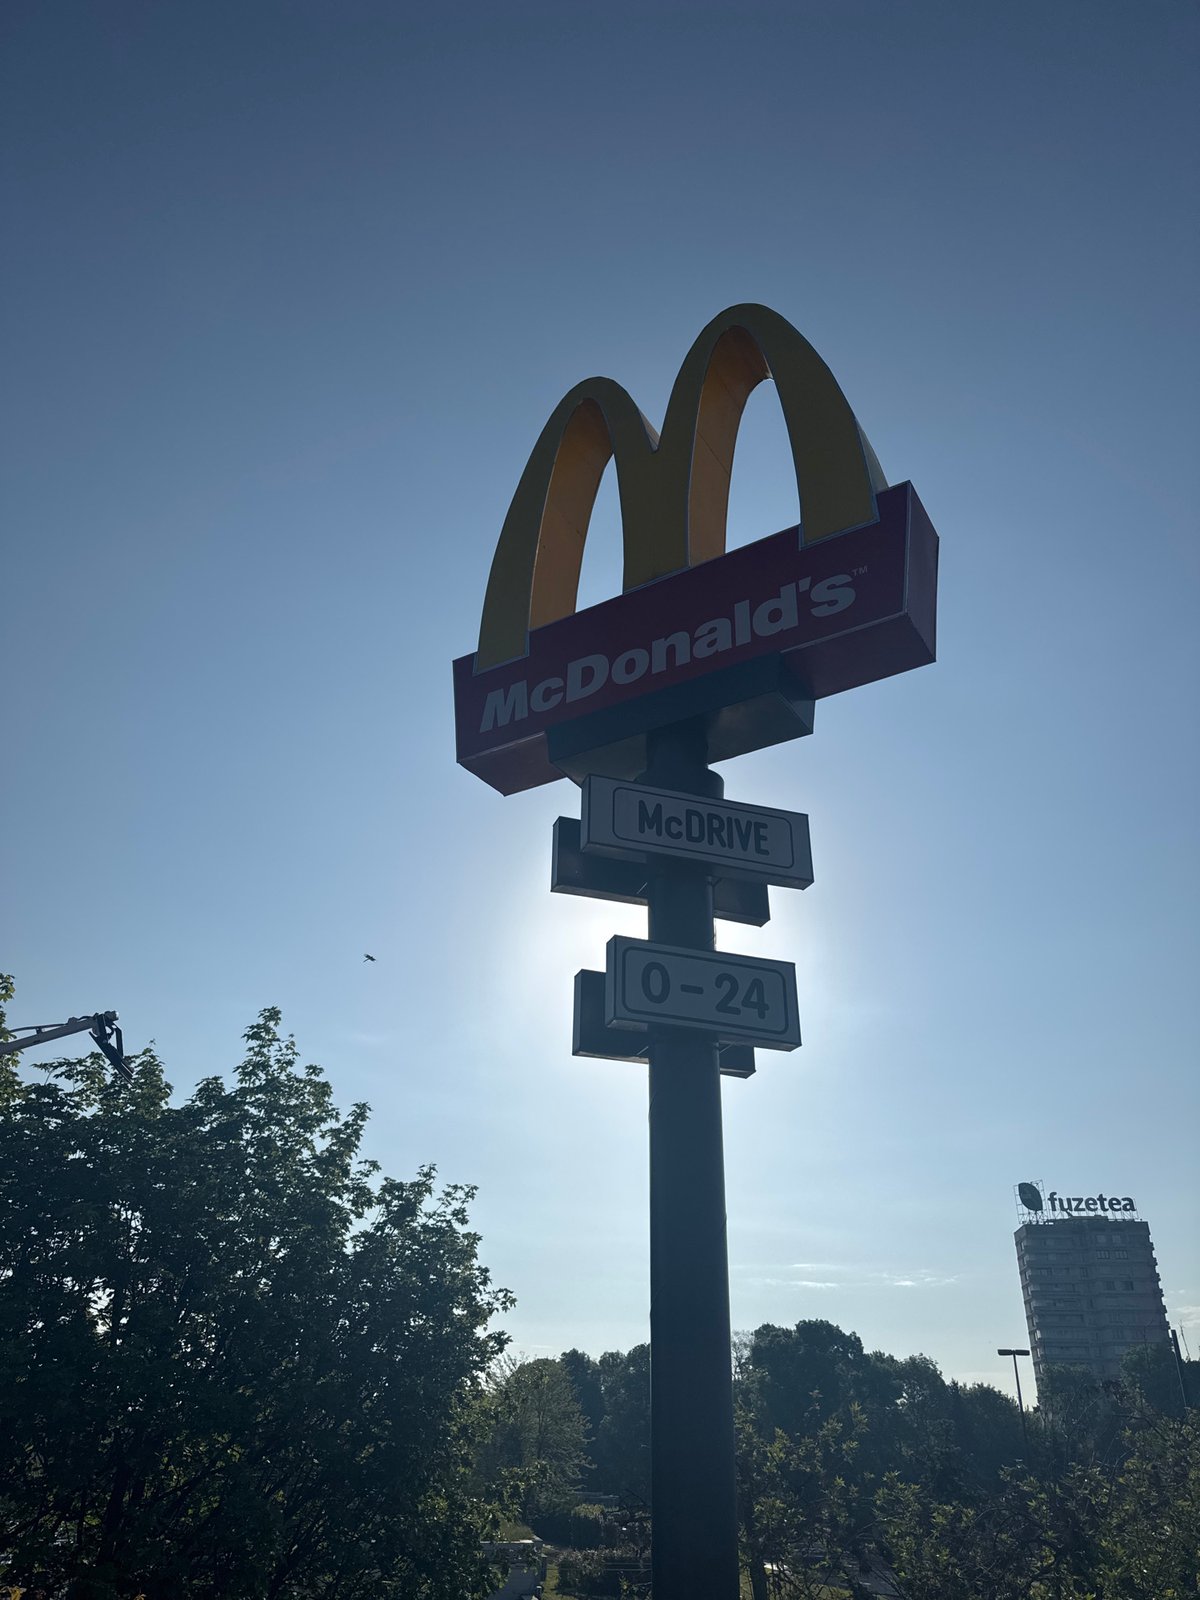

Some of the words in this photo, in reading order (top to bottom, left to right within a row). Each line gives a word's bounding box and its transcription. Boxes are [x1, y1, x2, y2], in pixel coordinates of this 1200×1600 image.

[479, 571, 857, 734] McDonald's
[637, 799, 770, 856] McDRIVE
[1047, 1191, 1137, 1212] fuzetea
